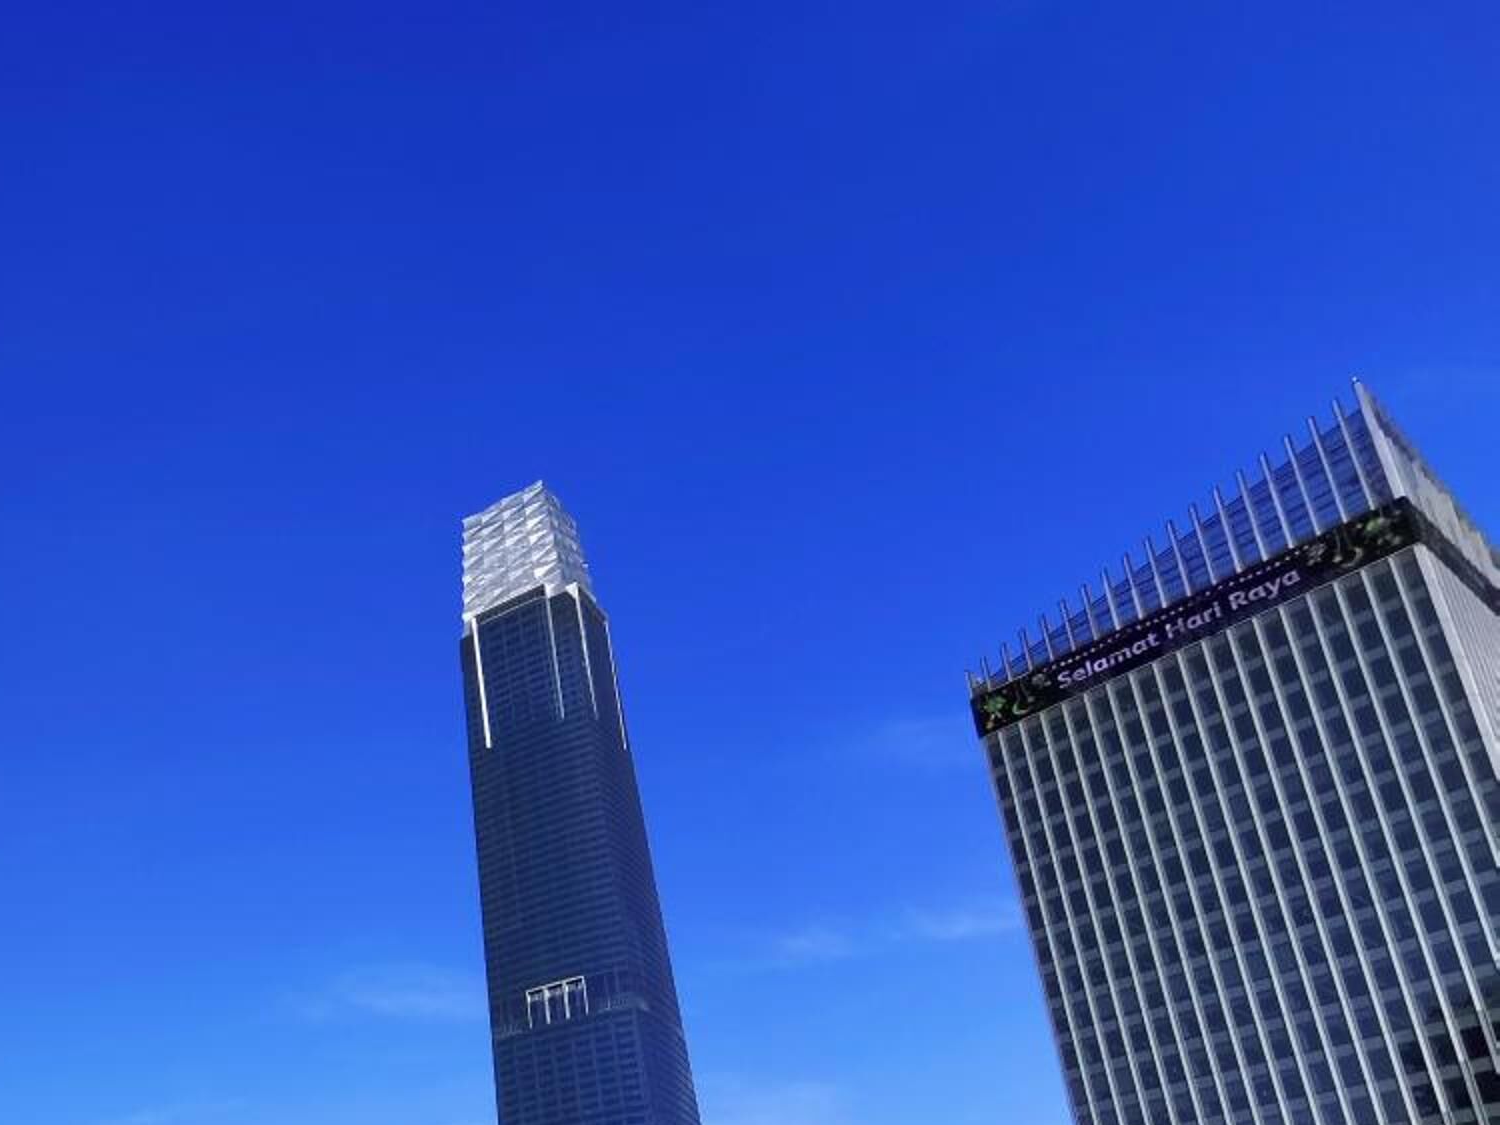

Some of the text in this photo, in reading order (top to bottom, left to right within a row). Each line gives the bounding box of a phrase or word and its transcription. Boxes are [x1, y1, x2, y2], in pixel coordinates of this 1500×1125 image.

[1057, 570, 1301, 689] Selamat Hari Raya
